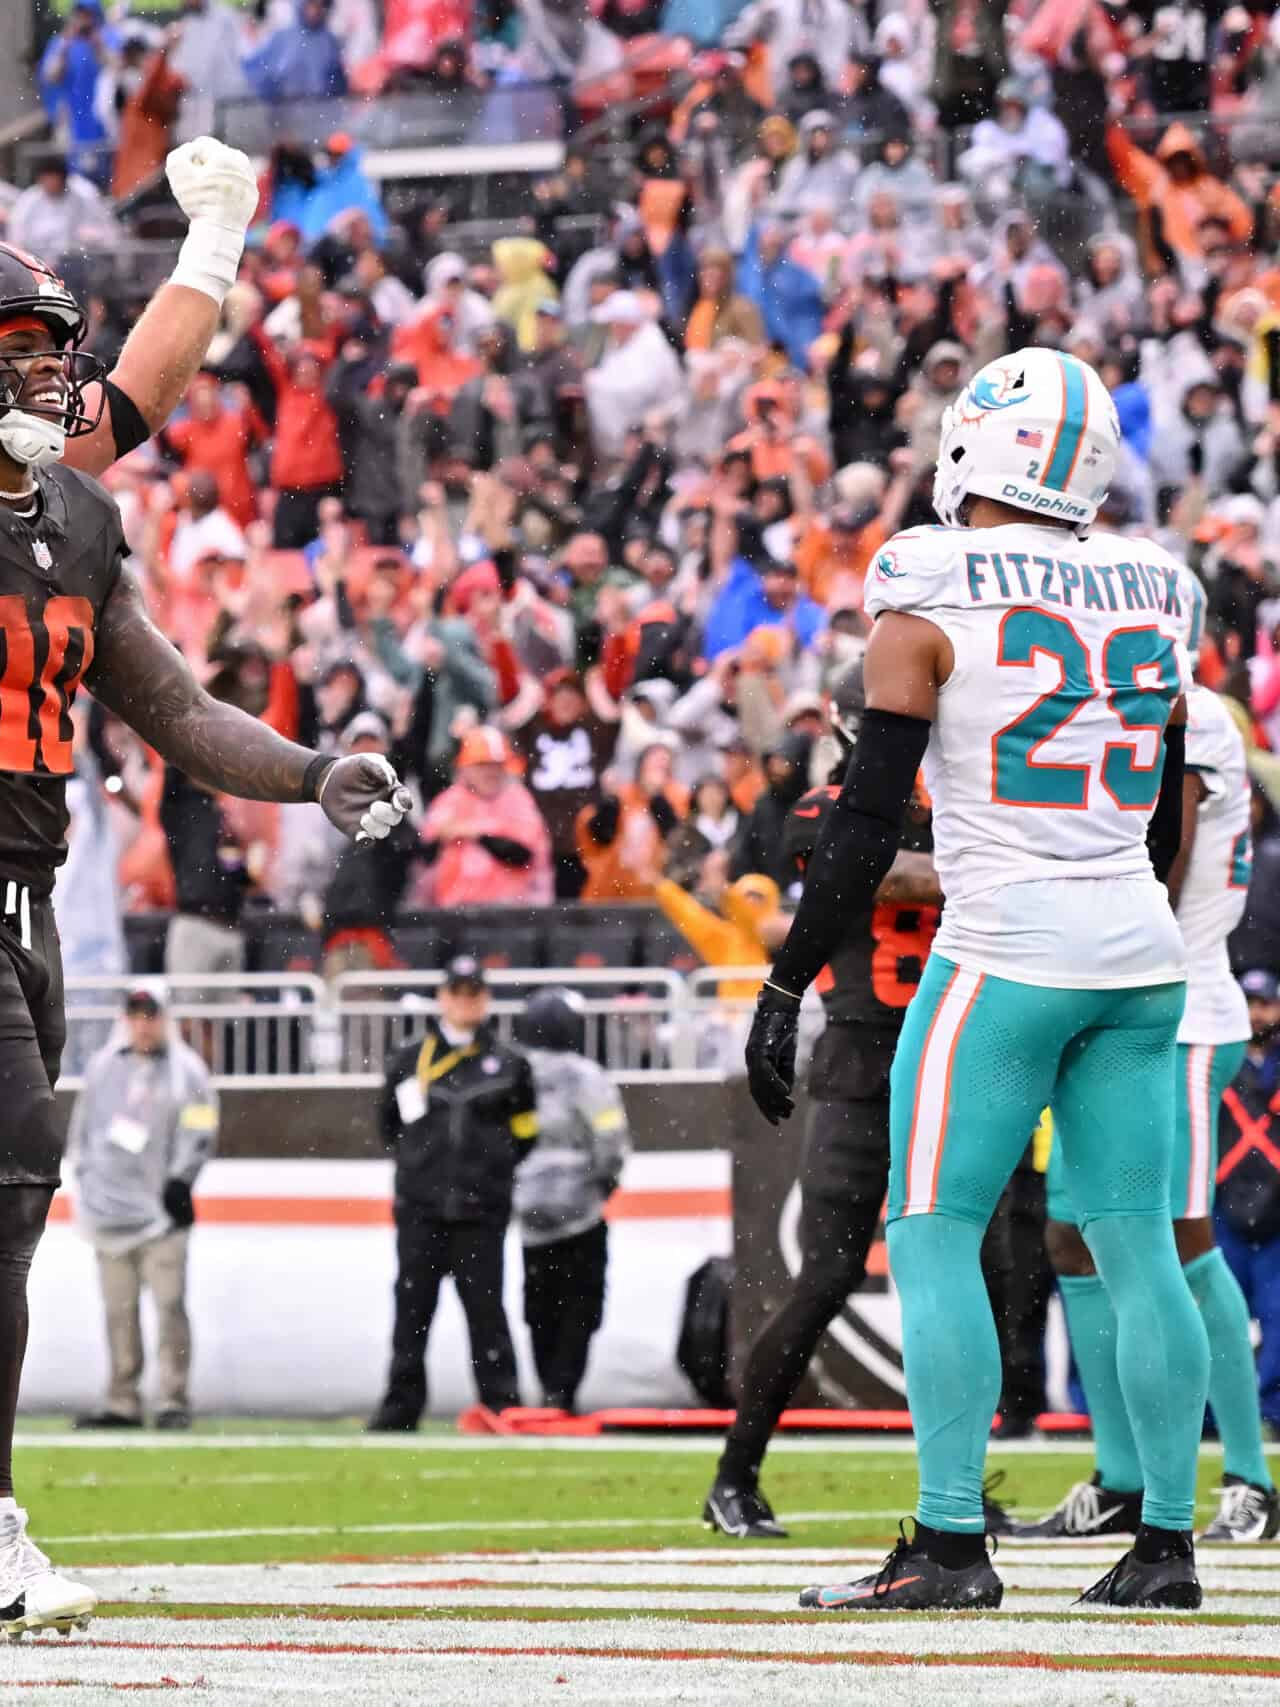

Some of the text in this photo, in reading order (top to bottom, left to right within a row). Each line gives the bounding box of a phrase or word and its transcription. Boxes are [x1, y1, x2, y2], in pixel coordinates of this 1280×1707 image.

[1025, 460, 1041, 480] 2
[1001, 483, 1089, 517] Dolphins
[964, 552, 1182, 618] FITZPATRICK
[990, 604, 1182, 811] 29
